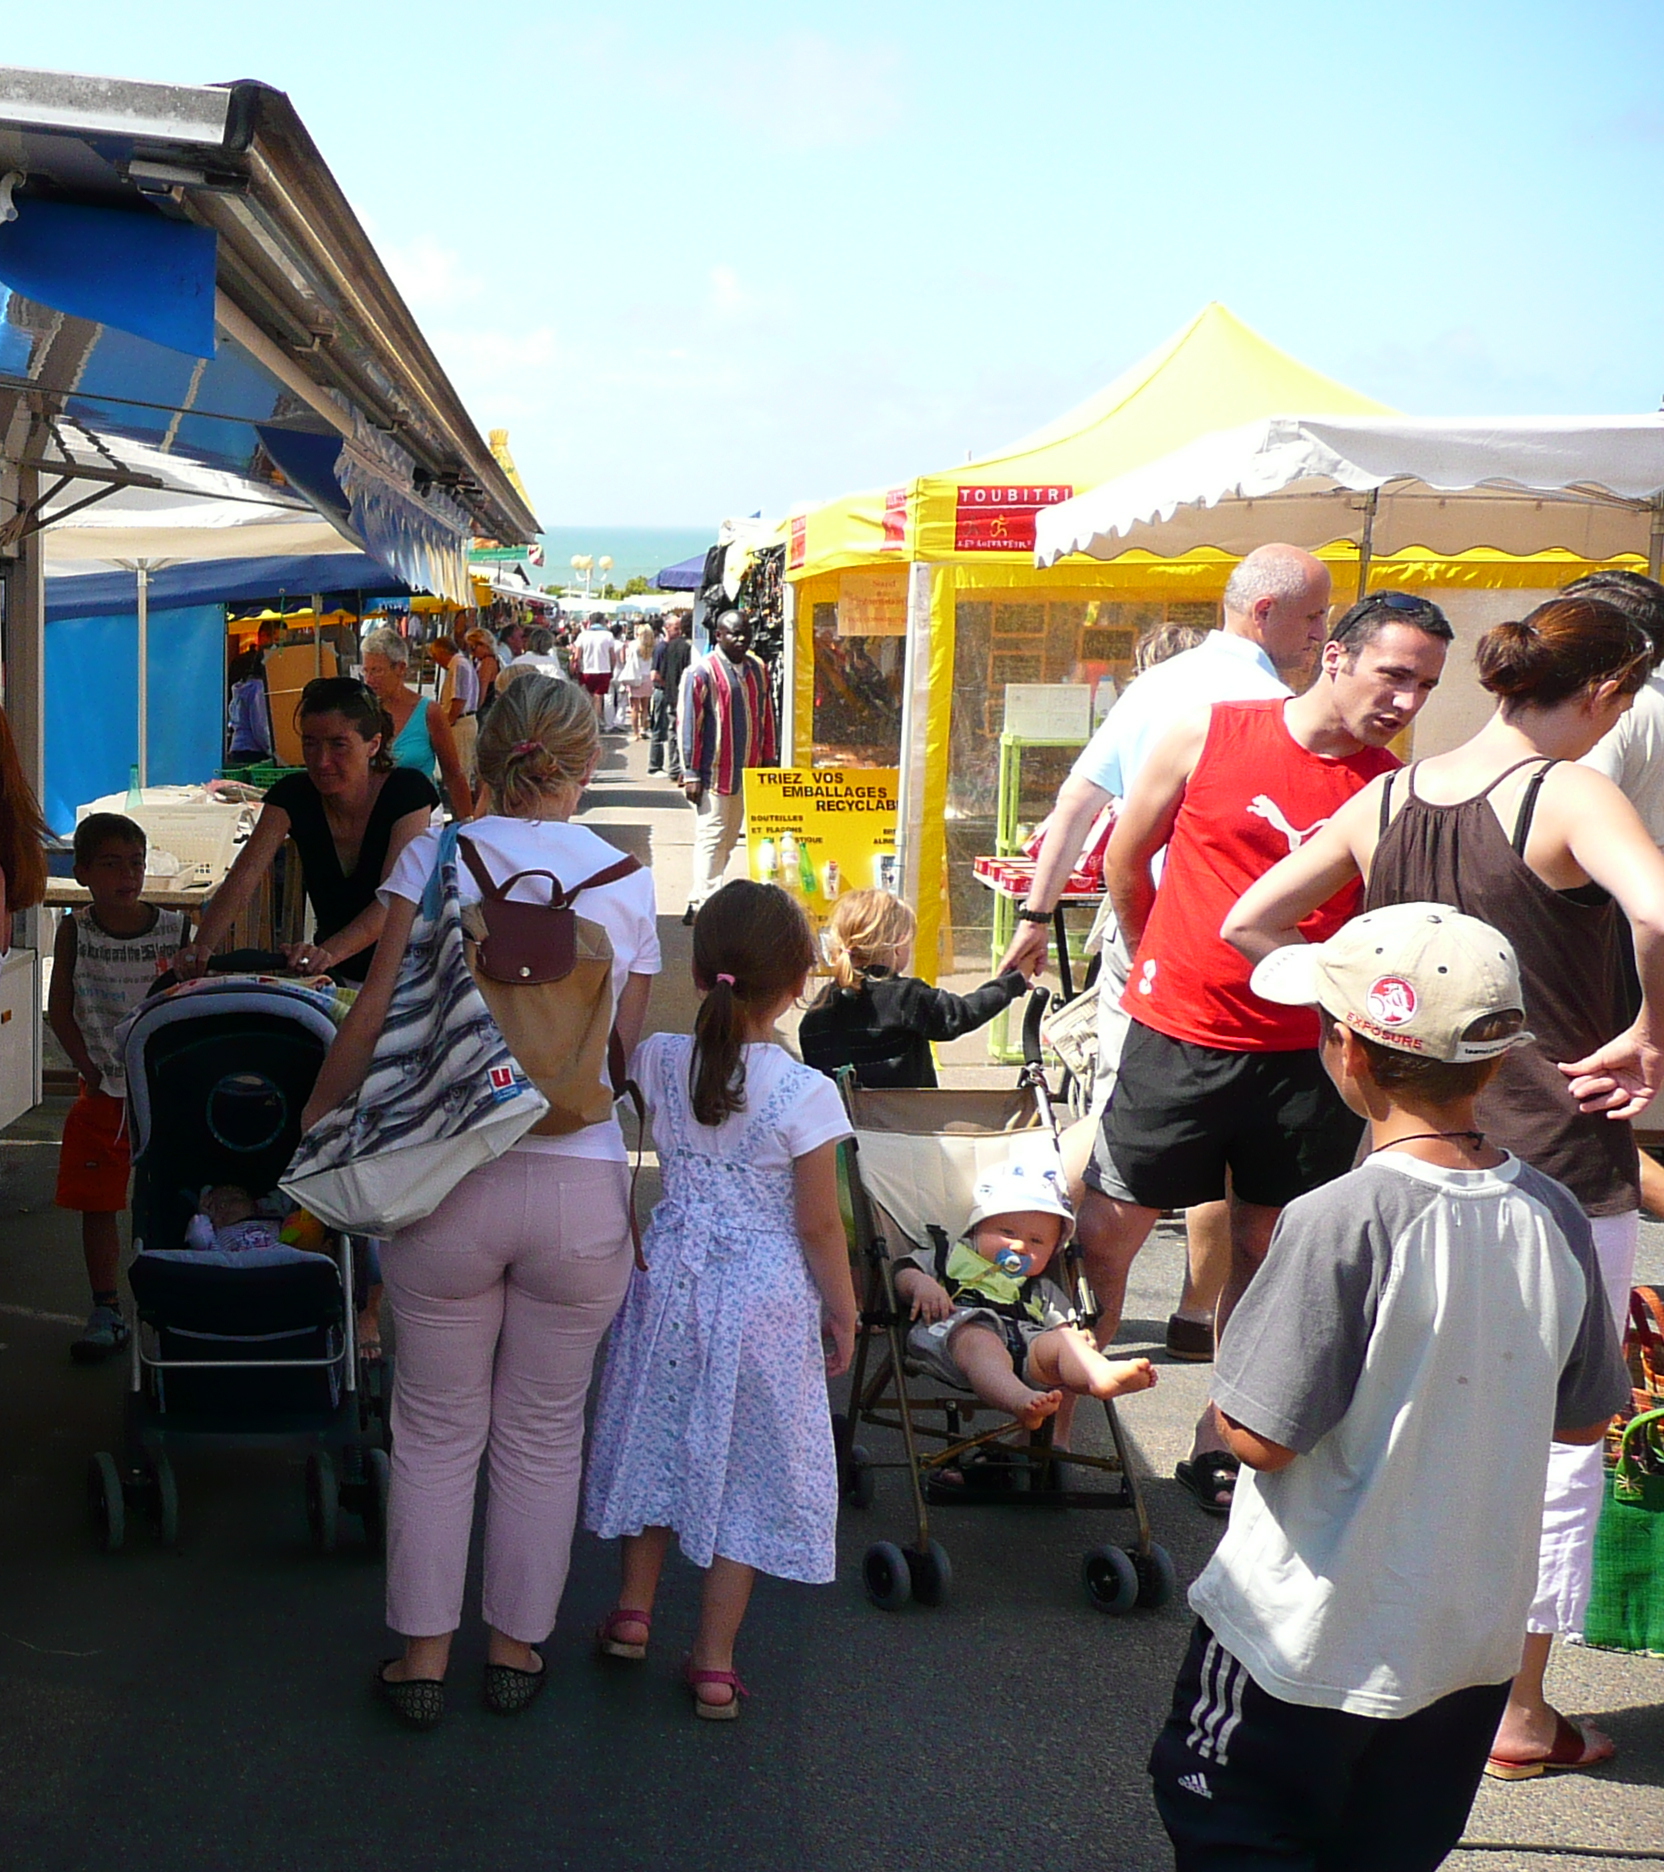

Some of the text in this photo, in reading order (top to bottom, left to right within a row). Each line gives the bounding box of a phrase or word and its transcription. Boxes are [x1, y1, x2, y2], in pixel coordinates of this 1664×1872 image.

[960, 488, 1069, 502] TOUBITRI
[757, 772, 844, 784] TRIEZ VOS
[782, 786, 888, 799] EMBALLAGES
[1346, 1011, 1424, 1049] EXPOSURE
